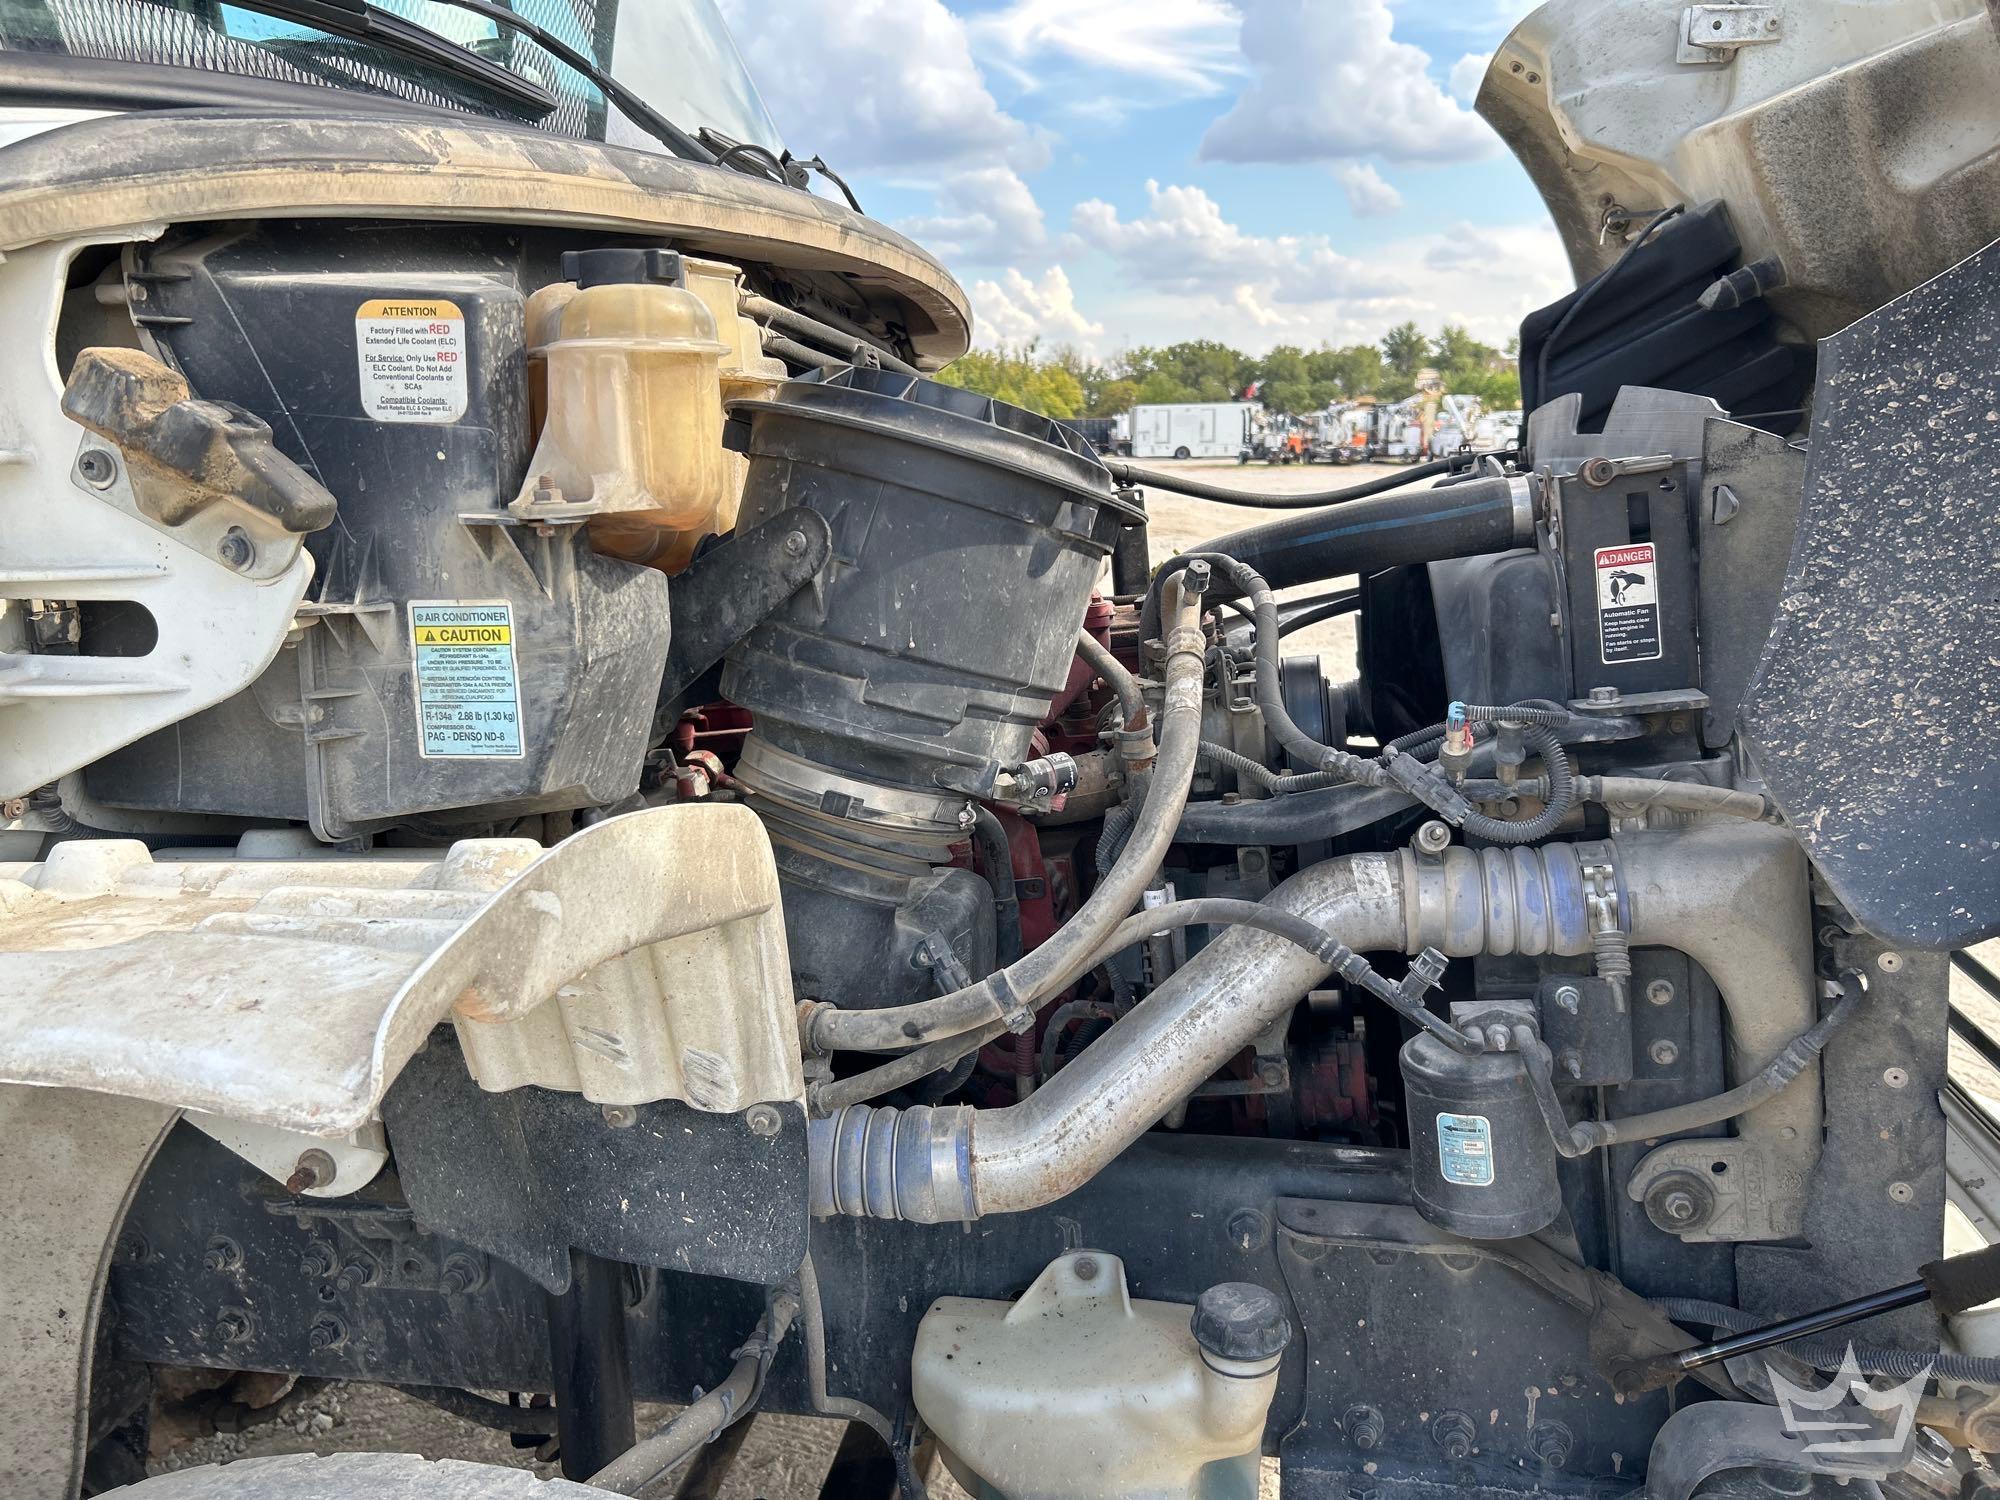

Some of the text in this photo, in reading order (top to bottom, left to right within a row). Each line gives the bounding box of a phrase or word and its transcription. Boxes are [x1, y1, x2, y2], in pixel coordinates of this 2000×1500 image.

[382, 307, 436, 316] ATTENTION
[370, 327, 393, 335] Factory
[429, 324, 450, 334] RED
[437, 352, 457, 362] RED
[1610, 551, 1651, 564] DANGER
[1604, 609, 1635, 618] Automatic
[440, 630, 501, 641] CAUTION
[426, 712, 452, 720] R-134a
[475, 712, 482, 720] lb
[484, 712, 502, 722] (1.30
[504, 712, 515, 722] kg)
[428, 732, 445, 741] PAG
[453, 732, 482, 740] DENSO
